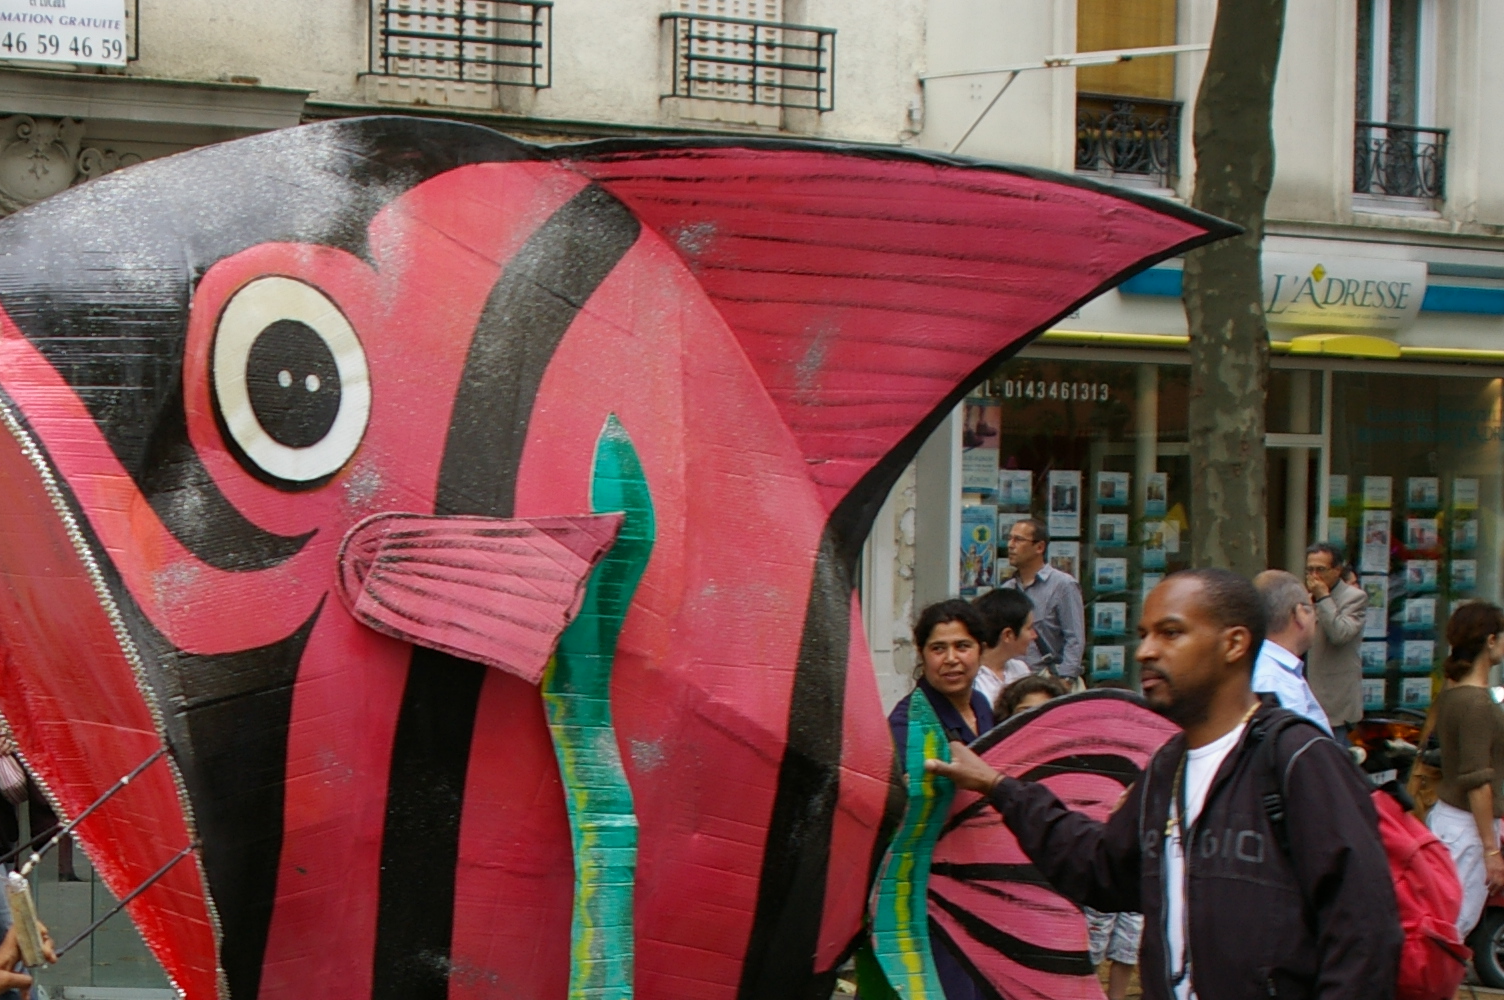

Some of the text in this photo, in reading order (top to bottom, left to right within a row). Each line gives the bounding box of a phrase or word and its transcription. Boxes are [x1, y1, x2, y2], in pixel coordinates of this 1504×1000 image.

[59, 15, 121, 30] GRATUITE
[1, 31, 27, 53] 46
[37, 34, 60, 55] 59
[69, 36, 93, 57] 46
[101, 38, 123, 60] 59
[1266, 273, 1411, 314] L'ADRESSE
